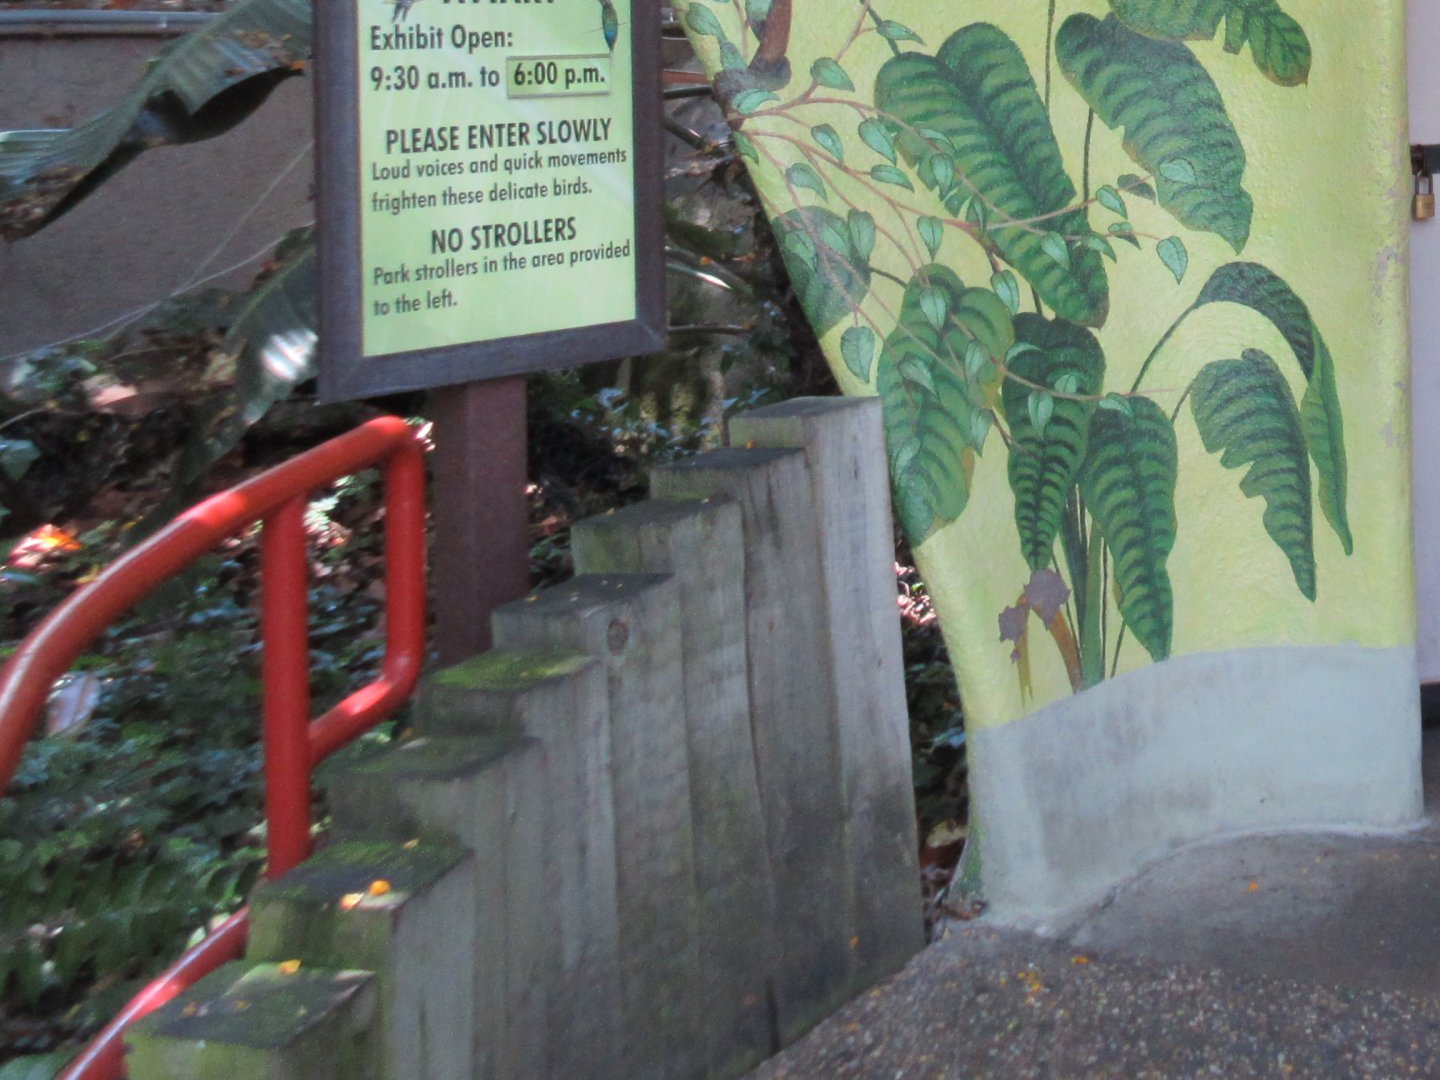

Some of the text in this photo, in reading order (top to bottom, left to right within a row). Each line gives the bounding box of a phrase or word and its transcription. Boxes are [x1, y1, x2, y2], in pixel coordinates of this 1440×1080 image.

[370, 25, 513, 54] Exhibit Open:
[370, 62, 606, 91] 9:30 a.m. to 6:00 p.m.
[386, 118, 612, 154] PLEASE ENTER SLOWLY
[372, 148, 627, 181] Loud voices and quick movements
[372, 177, 592, 215] frighten these delicate birds.
[431, 217, 577, 254] NO STROLLERS
[373, 239, 630, 286] Park strollers in the area provided
[373, 289, 457, 316] to the left.
